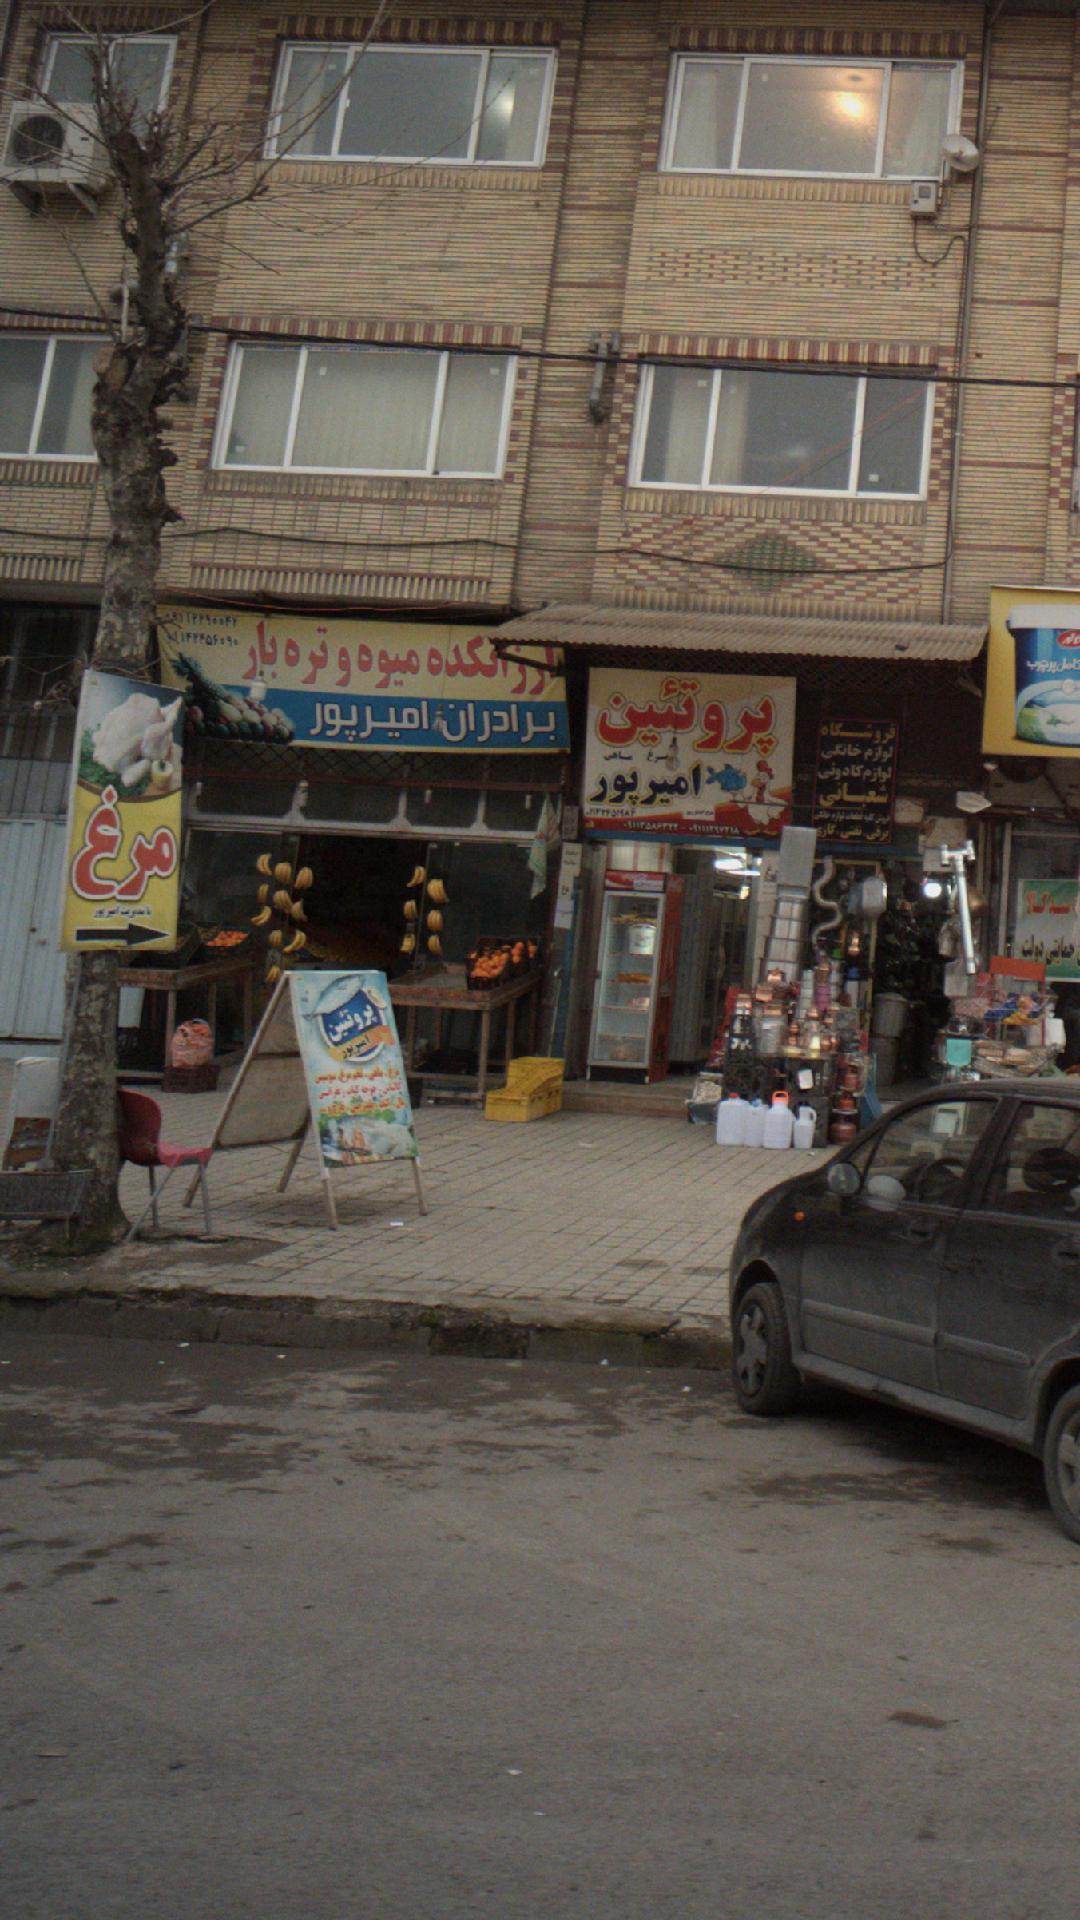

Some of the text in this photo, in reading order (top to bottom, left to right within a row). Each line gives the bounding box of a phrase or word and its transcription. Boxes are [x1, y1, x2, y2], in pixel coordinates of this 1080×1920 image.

[241, 620, 278, 681] بار
[283, 625, 329, 685] تره
[337, 646, 352, 688] و
[358, 644, 420, 689] میوه
[443, 701, 556, 746] برادران
[597, 677, 777, 755] پروتئین
[820, 723, 896, 744] فروشگاه
[820, 744, 893, 762] لوازم خانگی
[863, 766, 892, 783] لوازم
[819, 782, 888, 808] شعبانی
[72, 783, 177, 900] مرغ
[328, 1004, 378, 1043] پروتئین
